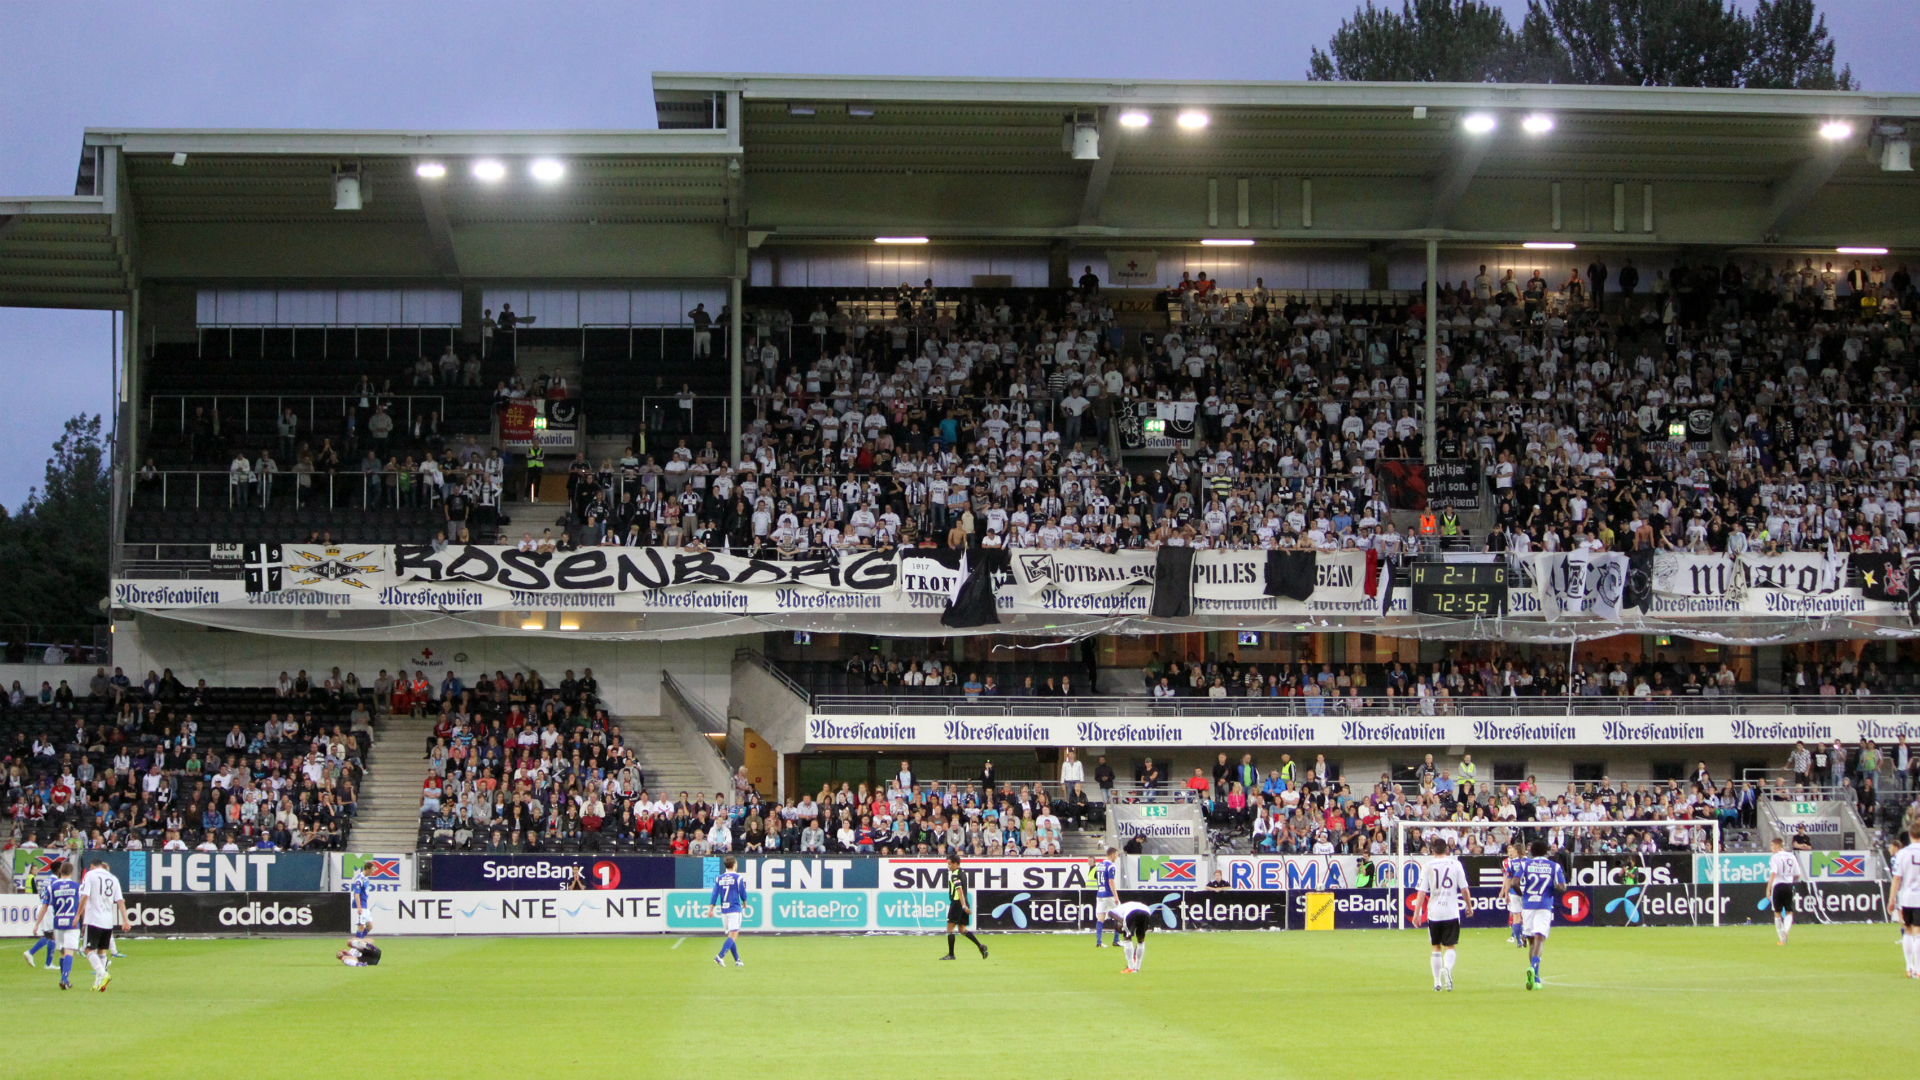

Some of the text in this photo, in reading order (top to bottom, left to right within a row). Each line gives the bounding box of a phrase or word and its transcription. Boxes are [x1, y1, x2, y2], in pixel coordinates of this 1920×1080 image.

[323, 566, 342, 575] RBK
[1056, 563, 1130, 583] FOTBALL
[1415, 568, 1424, 583] H
[1495, 568, 1504, 583] G
[115, 583, 219, 605] Adresseavisen
[378, 587, 483, 607] Adresseavisen
[643, 587, 748, 608] Adresseavisen
[776, 588, 881, 609] Adresseavisen
[1041, 588, 1146, 610] Adresseavisen
[1433, 593, 1489, 612] 72:52
[1766, 592, 1865, 612] Adresseavisen
[411, 658, 428, 667] Røde
[810, 719, 916, 741] Adresseavisen
[944, 720, 1049, 742] Adresseavisen
[1077, 721, 1182, 742] Adresseavisen
[1210, 721, 1315, 742] Adresseavisen
[1341, 721, 1445, 742] Adresseavisen
[1473, 721, 1576, 742] Adresseavisen
[1602, 720, 1704, 741] Adresseavisen
[1731, 719, 1832, 740] Adresseavisen
[1119, 822, 1190, 837] Adresseavisen
[151, 853, 276, 891] HENT
[1229, 859, 1349, 889] REMA
[1780, 858, 1794, 873] 19
[98, 876, 114, 897] 18
[893, 867, 1008, 889] SMTH
[1097, 871, 1106, 886] 14
[1433, 867, 1453, 889] 16
[1526, 873, 1552, 896] 27
[722, 885, 730, 901] 7
[1794, 890, 1881, 912] telenor
[55, 896, 75, 916] 22
[219, 902, 313, 925] adidas
[398, 899, 453, 919] NTE
[502, 898, 557, 919] NTE
[606, 897, 661, 918] NTE
[779, 899, 859, 919] vitaePro
[1179, 898, 1271, 922] telenor
[1372, 915, 1398, 923] SMN
